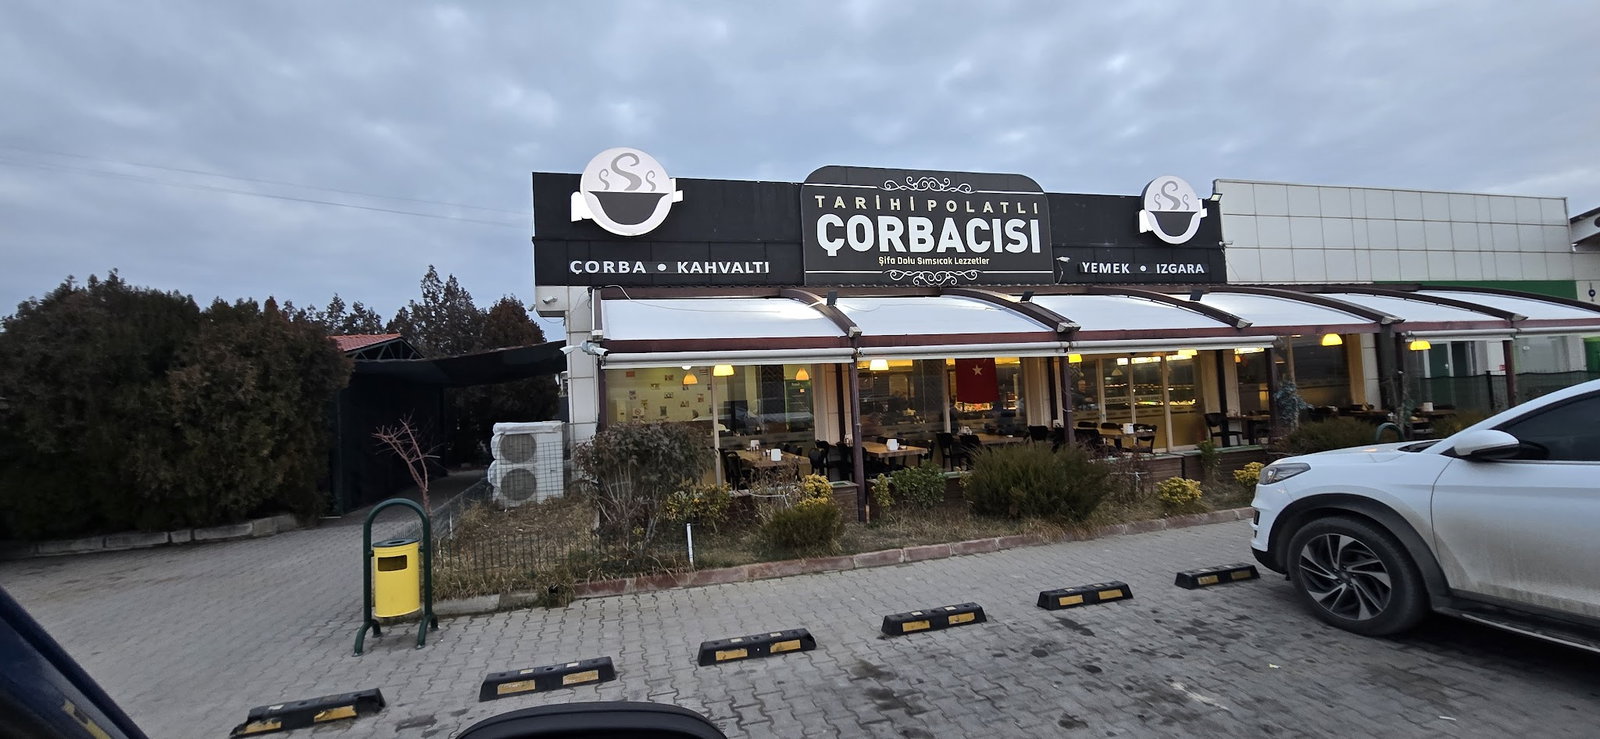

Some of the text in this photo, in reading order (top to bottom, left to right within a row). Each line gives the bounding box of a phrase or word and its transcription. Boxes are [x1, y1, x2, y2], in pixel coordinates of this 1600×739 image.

[815, 195, 1038, 214] TARİHİ POLATLI
[816, 214, 1041, 257] ÇORBACISI
[569, 260, 769, 275] ÇORBA KAHVALTI
[878, 256, 990, 266] Şifa Dolu Sımsıcak Lezzetler
[1082, 261, 1205, 274] YEMEK IZGARA
